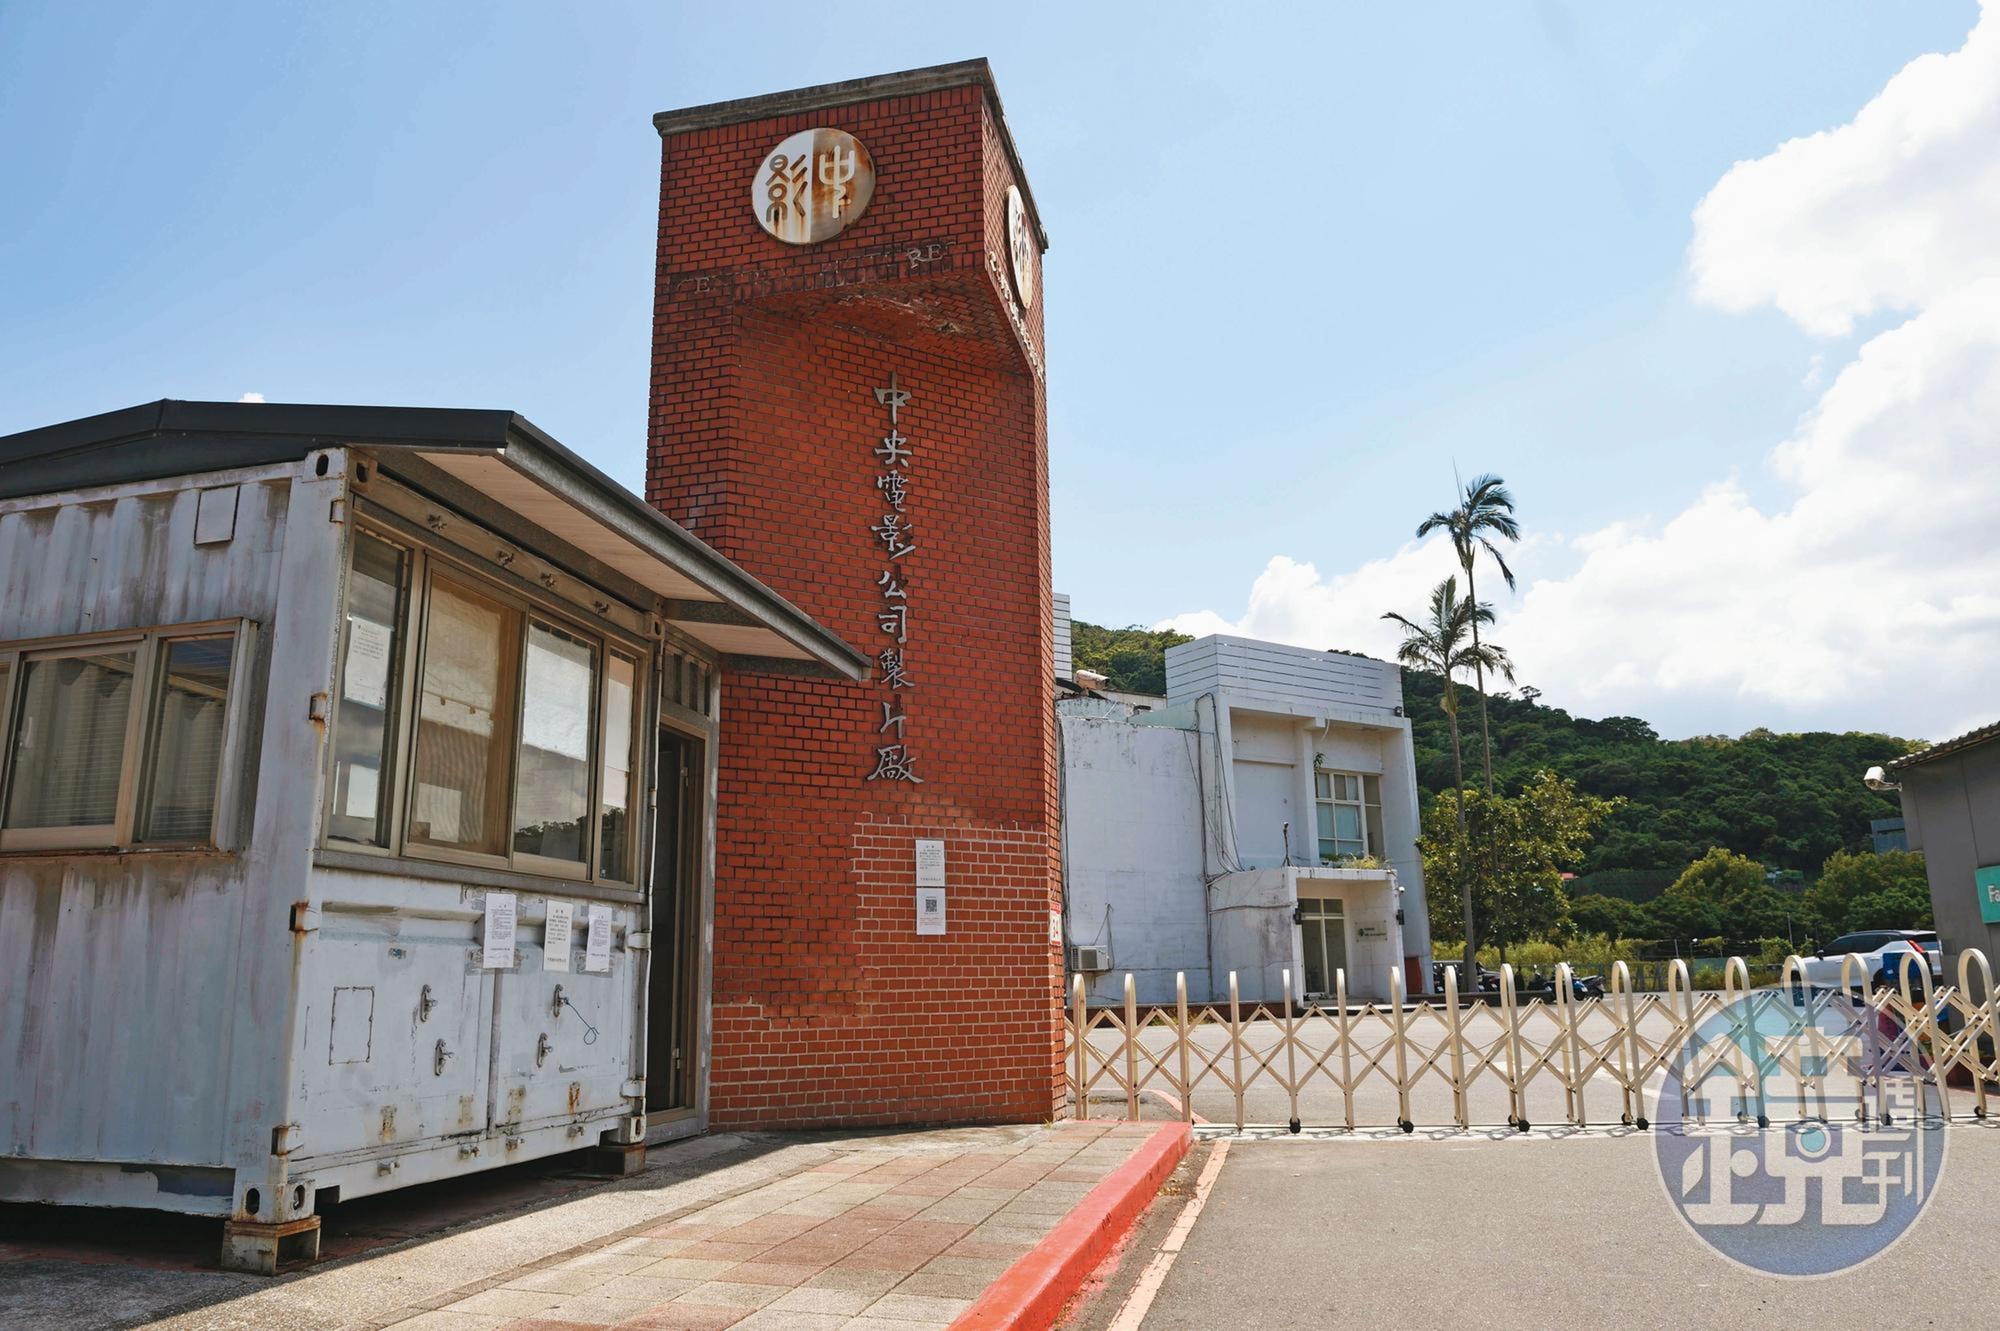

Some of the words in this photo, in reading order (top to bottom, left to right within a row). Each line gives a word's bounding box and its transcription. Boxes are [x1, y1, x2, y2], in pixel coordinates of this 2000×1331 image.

[867, 371, 924, 783] 中央電影公司製片廠
